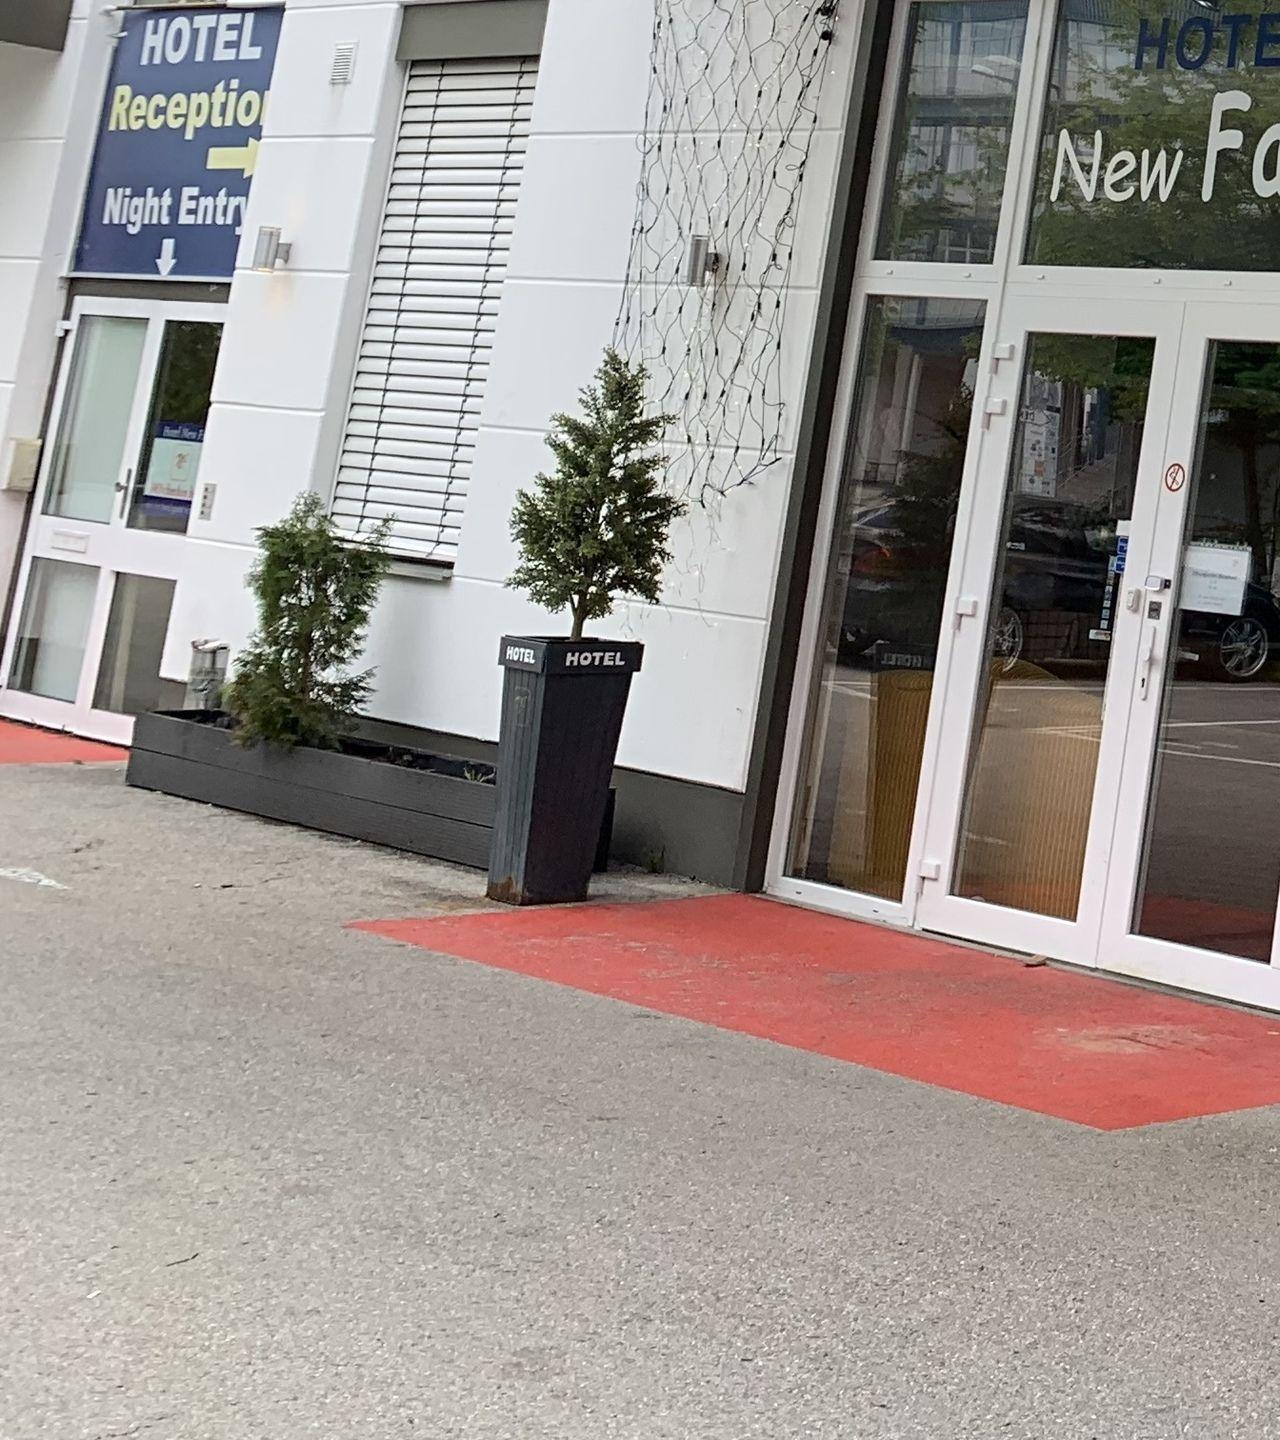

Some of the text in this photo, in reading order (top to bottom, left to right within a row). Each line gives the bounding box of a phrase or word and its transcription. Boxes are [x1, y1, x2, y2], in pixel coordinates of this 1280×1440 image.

[140, 12, 262, 65] HOTEL
[1050, 128, 1183, 203] New
[102, 186, 173, 235] Night
[505, 645, 536, 664] HOTEL
[565, 651, 626, 667] HOTEL
